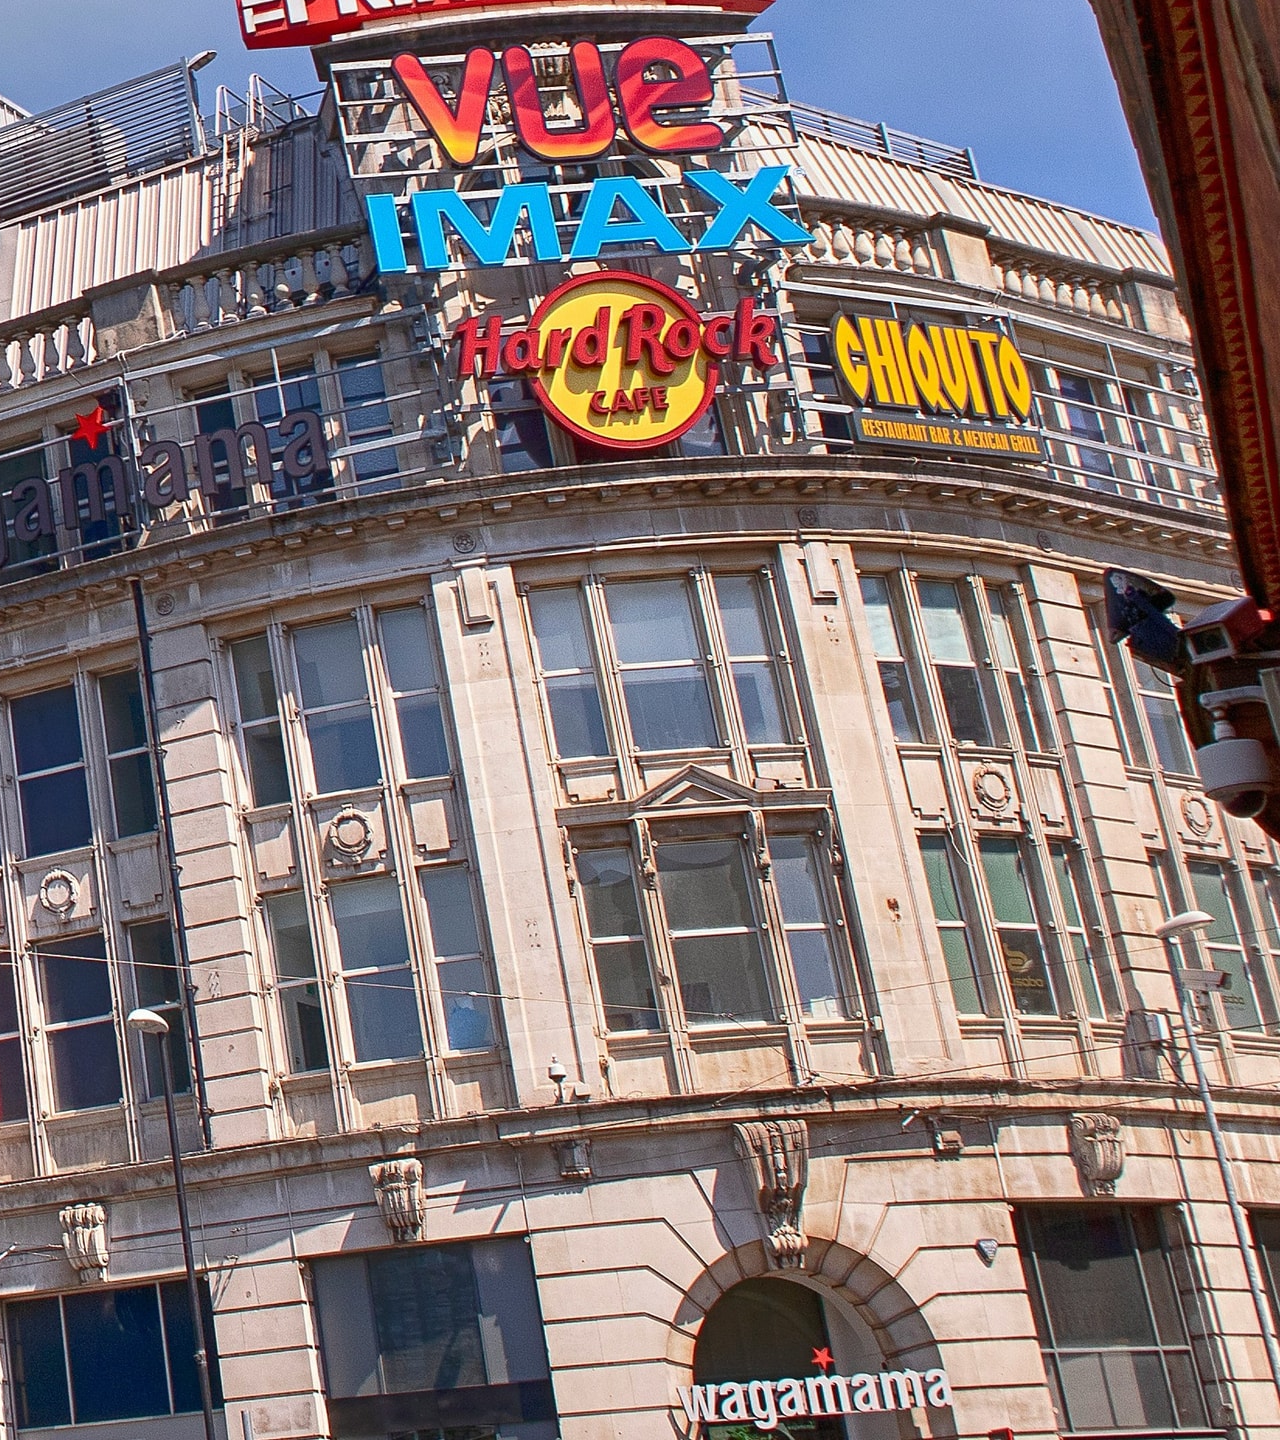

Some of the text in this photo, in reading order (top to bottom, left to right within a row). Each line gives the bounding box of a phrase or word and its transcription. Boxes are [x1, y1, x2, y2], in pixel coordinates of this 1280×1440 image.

[455, 297, 778, 379] Hard Rock
[834, 315, 1032, 418] CHIQUITO
[589, 385, 669, 414] CAFE
[861, 418, 1041, 454] RESTAURANT BAR & MEXICAN GRILL
[677, 1367, 953, 1430] wagamama
